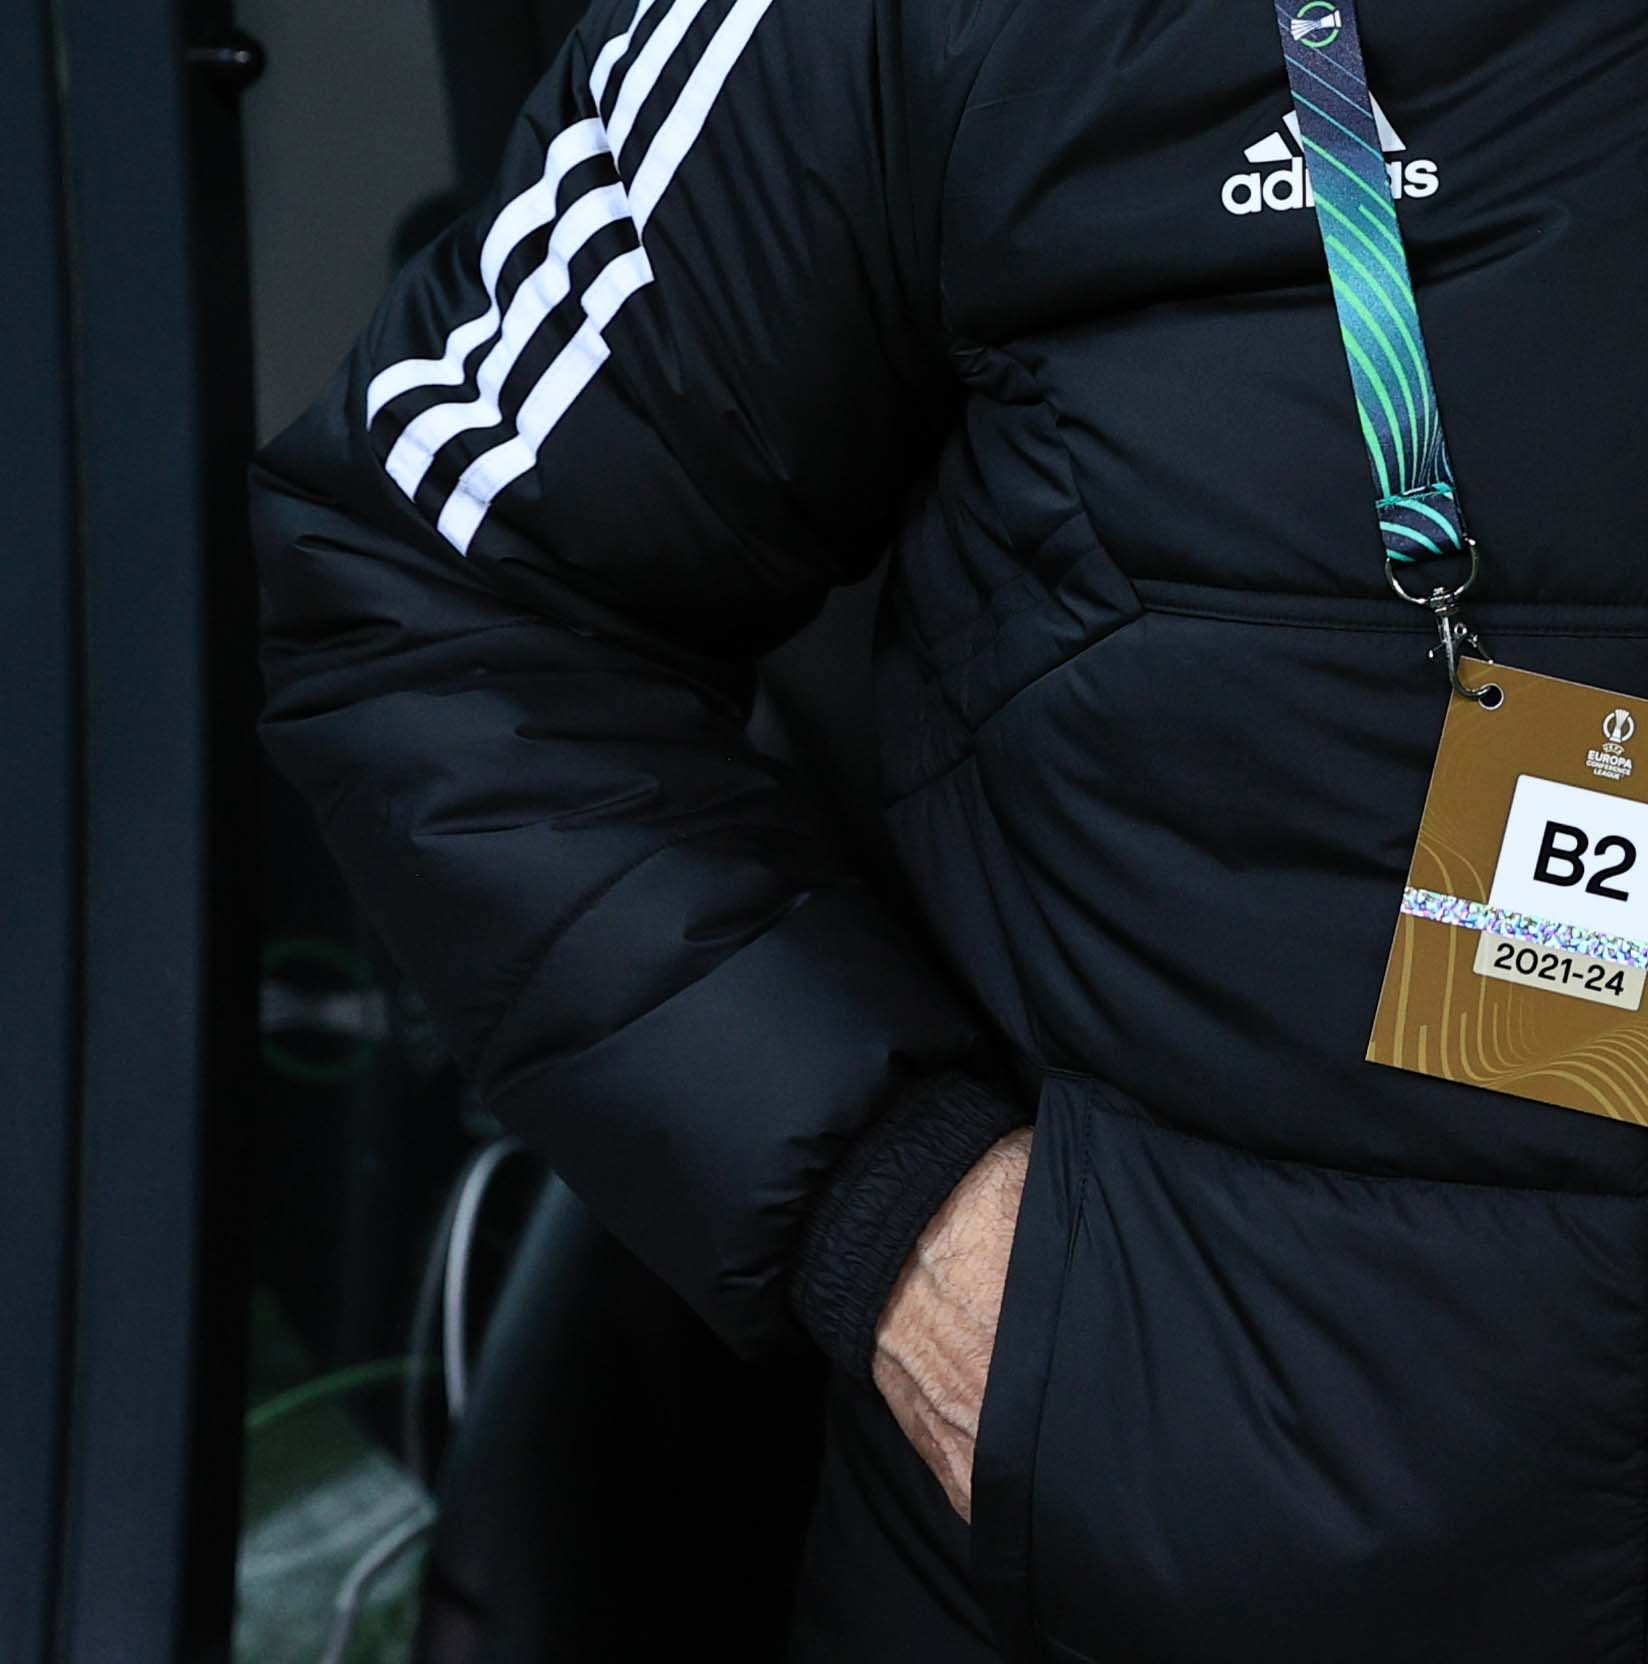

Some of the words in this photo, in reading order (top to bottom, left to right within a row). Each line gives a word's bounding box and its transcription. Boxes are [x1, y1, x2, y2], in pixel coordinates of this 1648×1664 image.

[1587, 749, 1633, 770] EUROPA
[1533, 820, 1637, 902] B2
[1493, 942, 1626, 997] 2021-24
